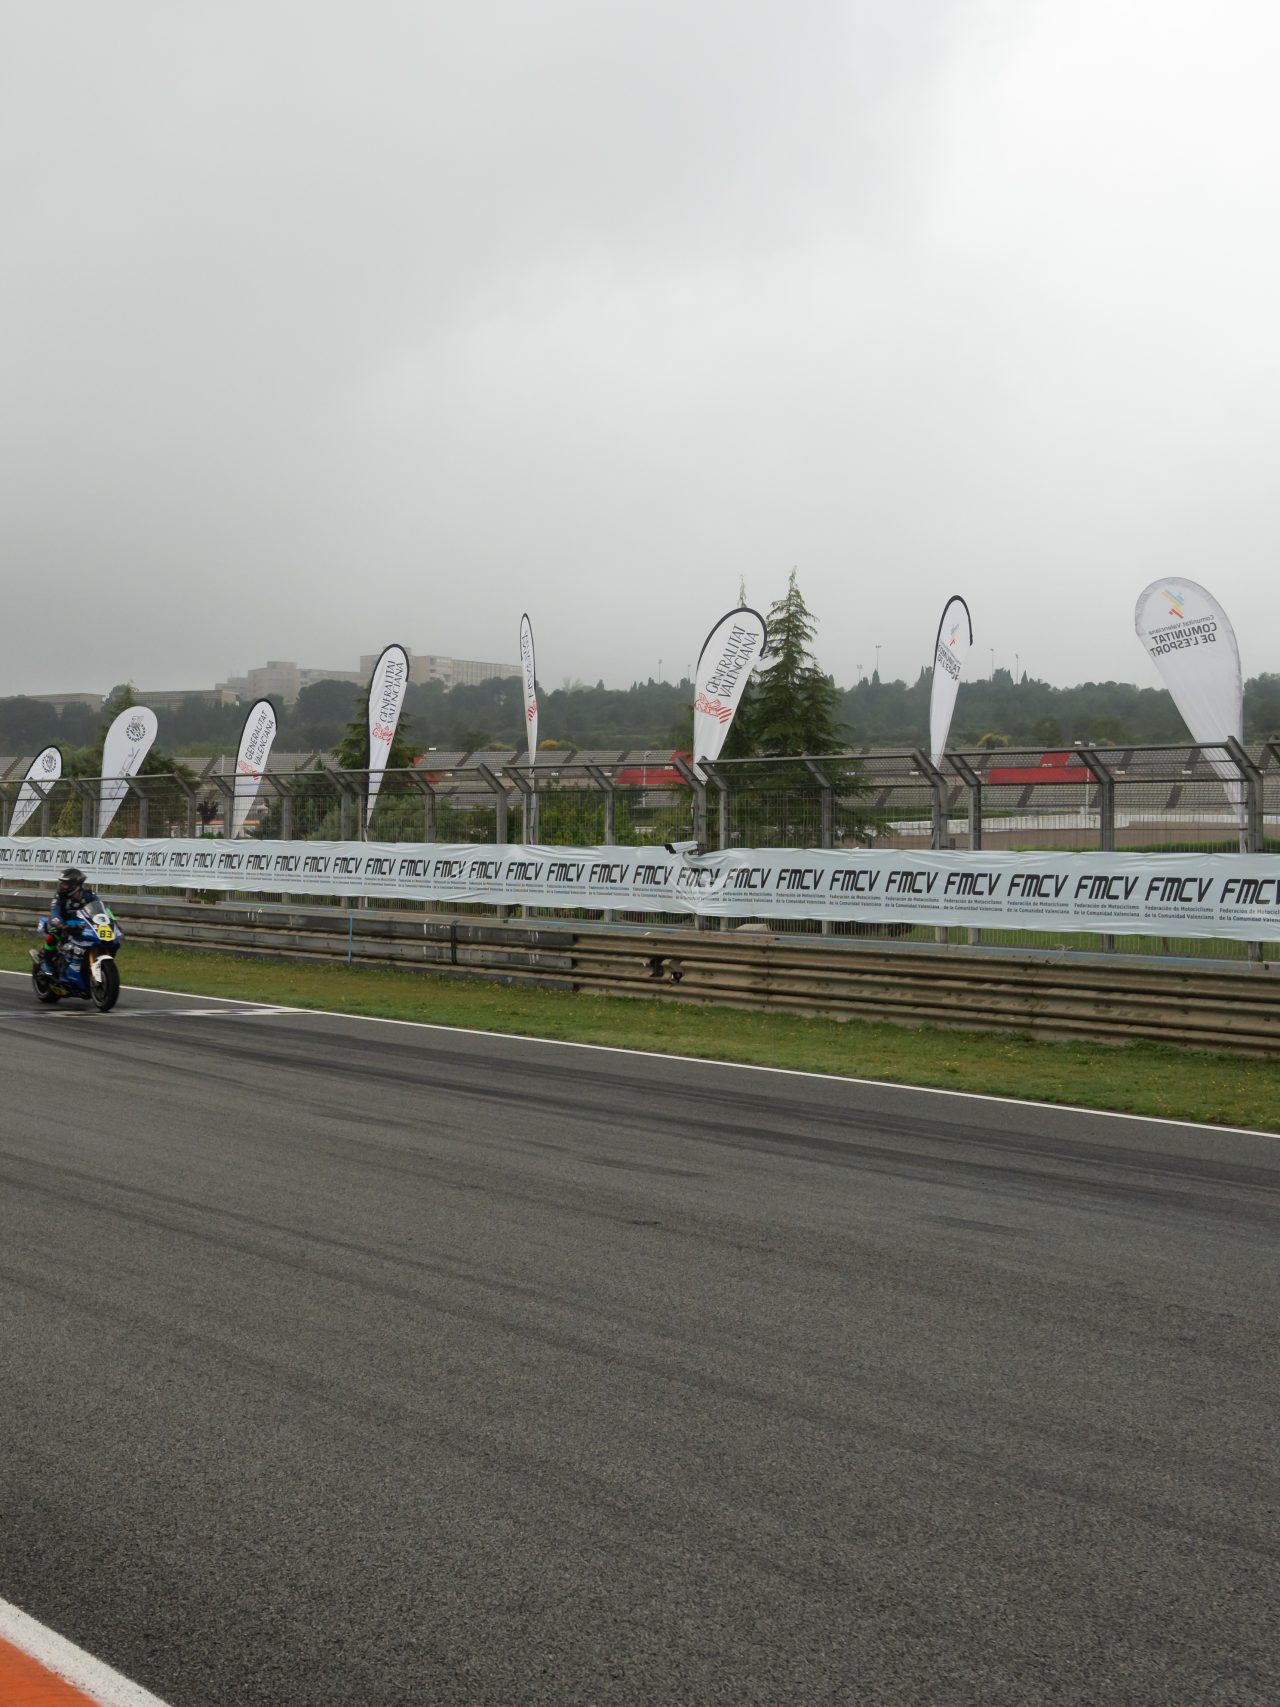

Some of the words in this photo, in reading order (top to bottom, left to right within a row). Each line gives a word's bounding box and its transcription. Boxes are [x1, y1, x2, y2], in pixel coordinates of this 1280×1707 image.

[705, 623, 746, 694] GENERALITAT
[718, 632, 760, 698] VALENCIANA
[380, 659, 397, 723] GENERALITAT
[386, 662, 404, 725] VALENCIANA
[244, 709, 268, 761] GENERALITAT
[253, 719, 275, 766] VALENCIANA
[15, 849, 34, 862] FMCV
[35, 849, 54, 863] FMCV
[56, 850, 75, 863] FMCV
[76, 850, 96, 865] FMCV
[98, 851, 120, 866] FMCV
[121, 851, 143, 866] FMCV
[169, 852, 192, 867] FMCV
[193, 853, 216, 868] FMCV
[218, 853, 244, 870] FMCV
[246, 854, 272, 871] FMCV
[274, 855, 301, 872] FMCV
[303, 856, 331, 873] FMCV
[333, 857, 362, 874] FMCV
[365, 858, 396, 875] FMCV
[399, 859, 430, 877] FMCV
[433, 860, 466, 878] FMCV
[469, 861, 502, 880] FMCV
[506, 862, 544, 881] FMCV
[546, 863, 585, 882] FMCV
[589, 864, 629, 883] FMCV
[633, 865, 674, 886] FMCV
[723, 868, 772, 889] FMCV
[776, 868, 825, 890] FMCV
[829, 869, 881, 892] FMCV
[885, 871, 939, 894] FMCV
[943, 872, 1002, 896] FMCV
[1007, 873, 1069, 898] FMCV
[1074, 875, 1140, 901] FMCV
[1144, 876, 1214, 903] FMCV
[99, 930, 112, 938] 83
